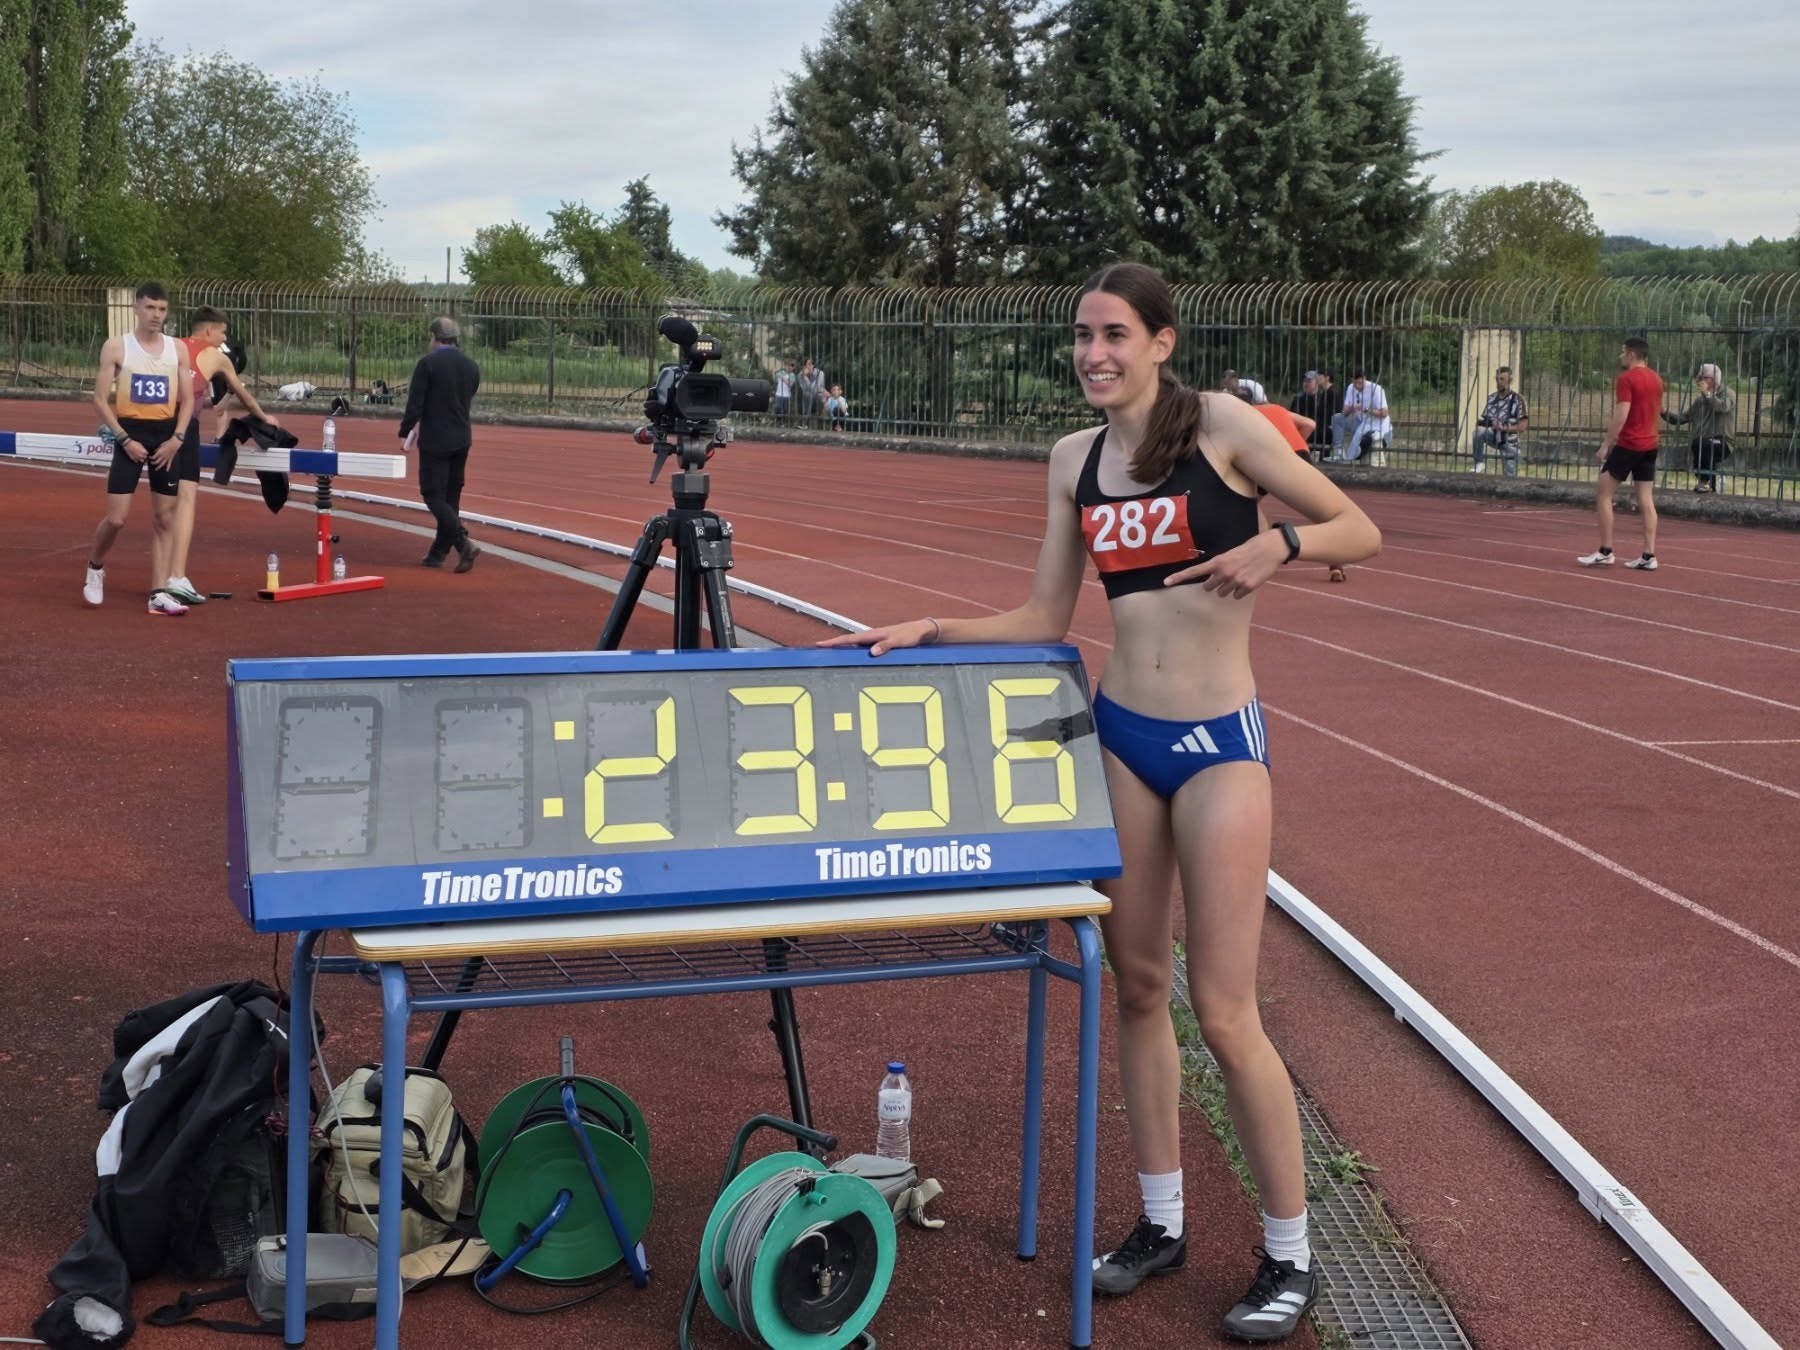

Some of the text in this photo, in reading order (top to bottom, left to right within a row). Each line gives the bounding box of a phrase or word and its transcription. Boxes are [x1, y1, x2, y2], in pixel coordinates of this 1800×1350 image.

[134, 379, 166, 398] 133
[86, 443, 113, 456] pola
[1091, 497, 1181, 552] 282
[815, 840, 992, 881] TimeTronics
[421, 863, 623, 906] TimeTronics
